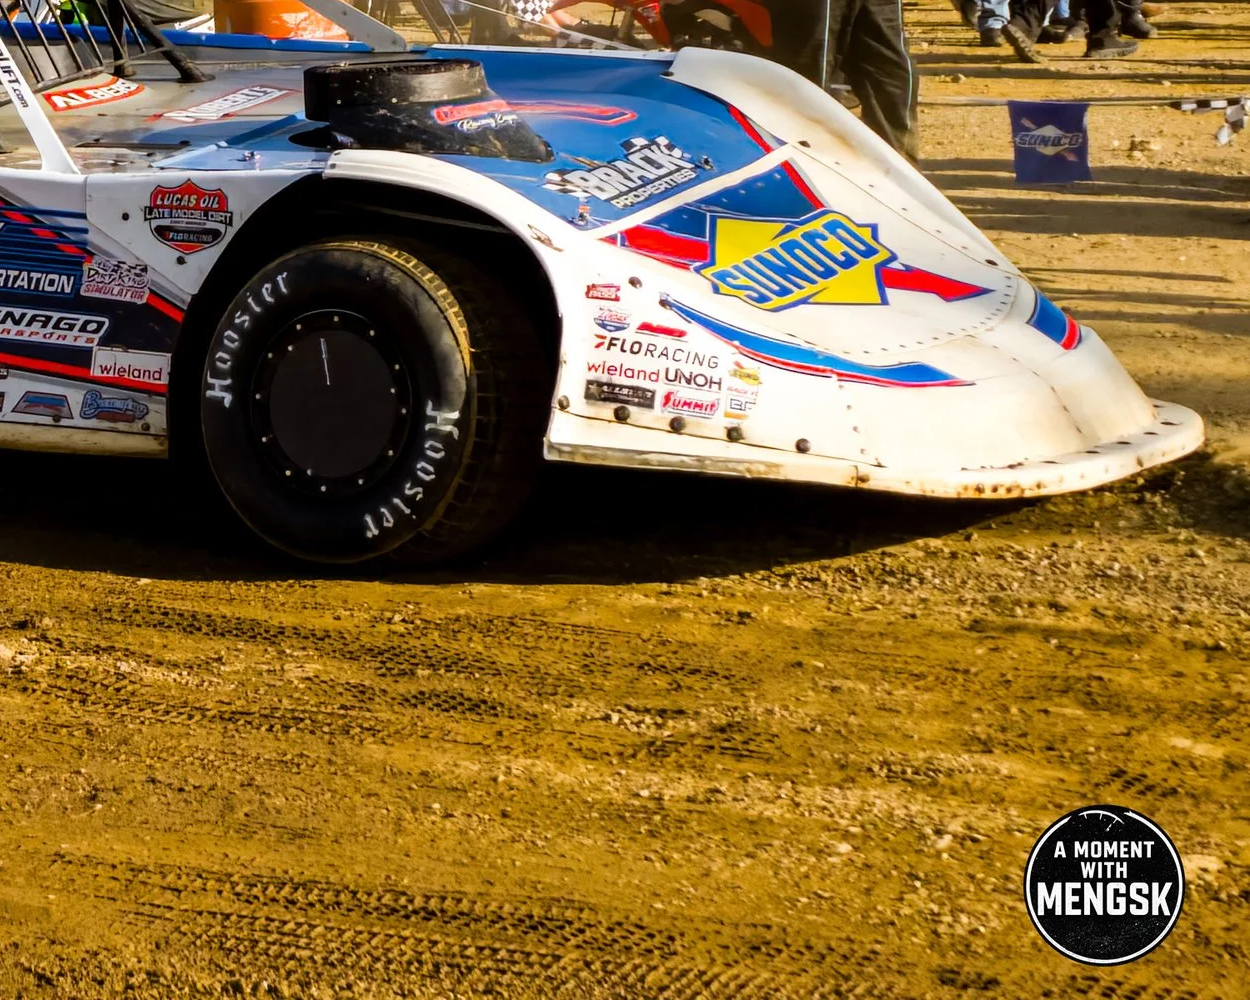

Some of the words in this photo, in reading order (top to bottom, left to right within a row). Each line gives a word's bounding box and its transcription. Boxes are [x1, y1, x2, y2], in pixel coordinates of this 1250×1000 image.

[1015, 133, 1083, 147] SUNOCO
[568, 145, 695, 201] BRACK
[156, 193, 198, 207] LUCAS
[200, 194, 220, 208] OIL
[612, 167, 698, 210] PROPERTIES
[145, 207, 171, 218] LATE
[172, 208, 208, 219] MODEL
[208, 211, 233, 224] DIRT
[710, 218, 881, 305] SUNOCO
[84, 283, 146, 301] SIMULATOR
[205, 270, 291, 409] Hoosier
[99, 362, 163, 382] wieland
[586, 361, 660, 383] wieland
[664, 367, 723, 391] UNOH
[364, 400, 461, 539] Hoosier
